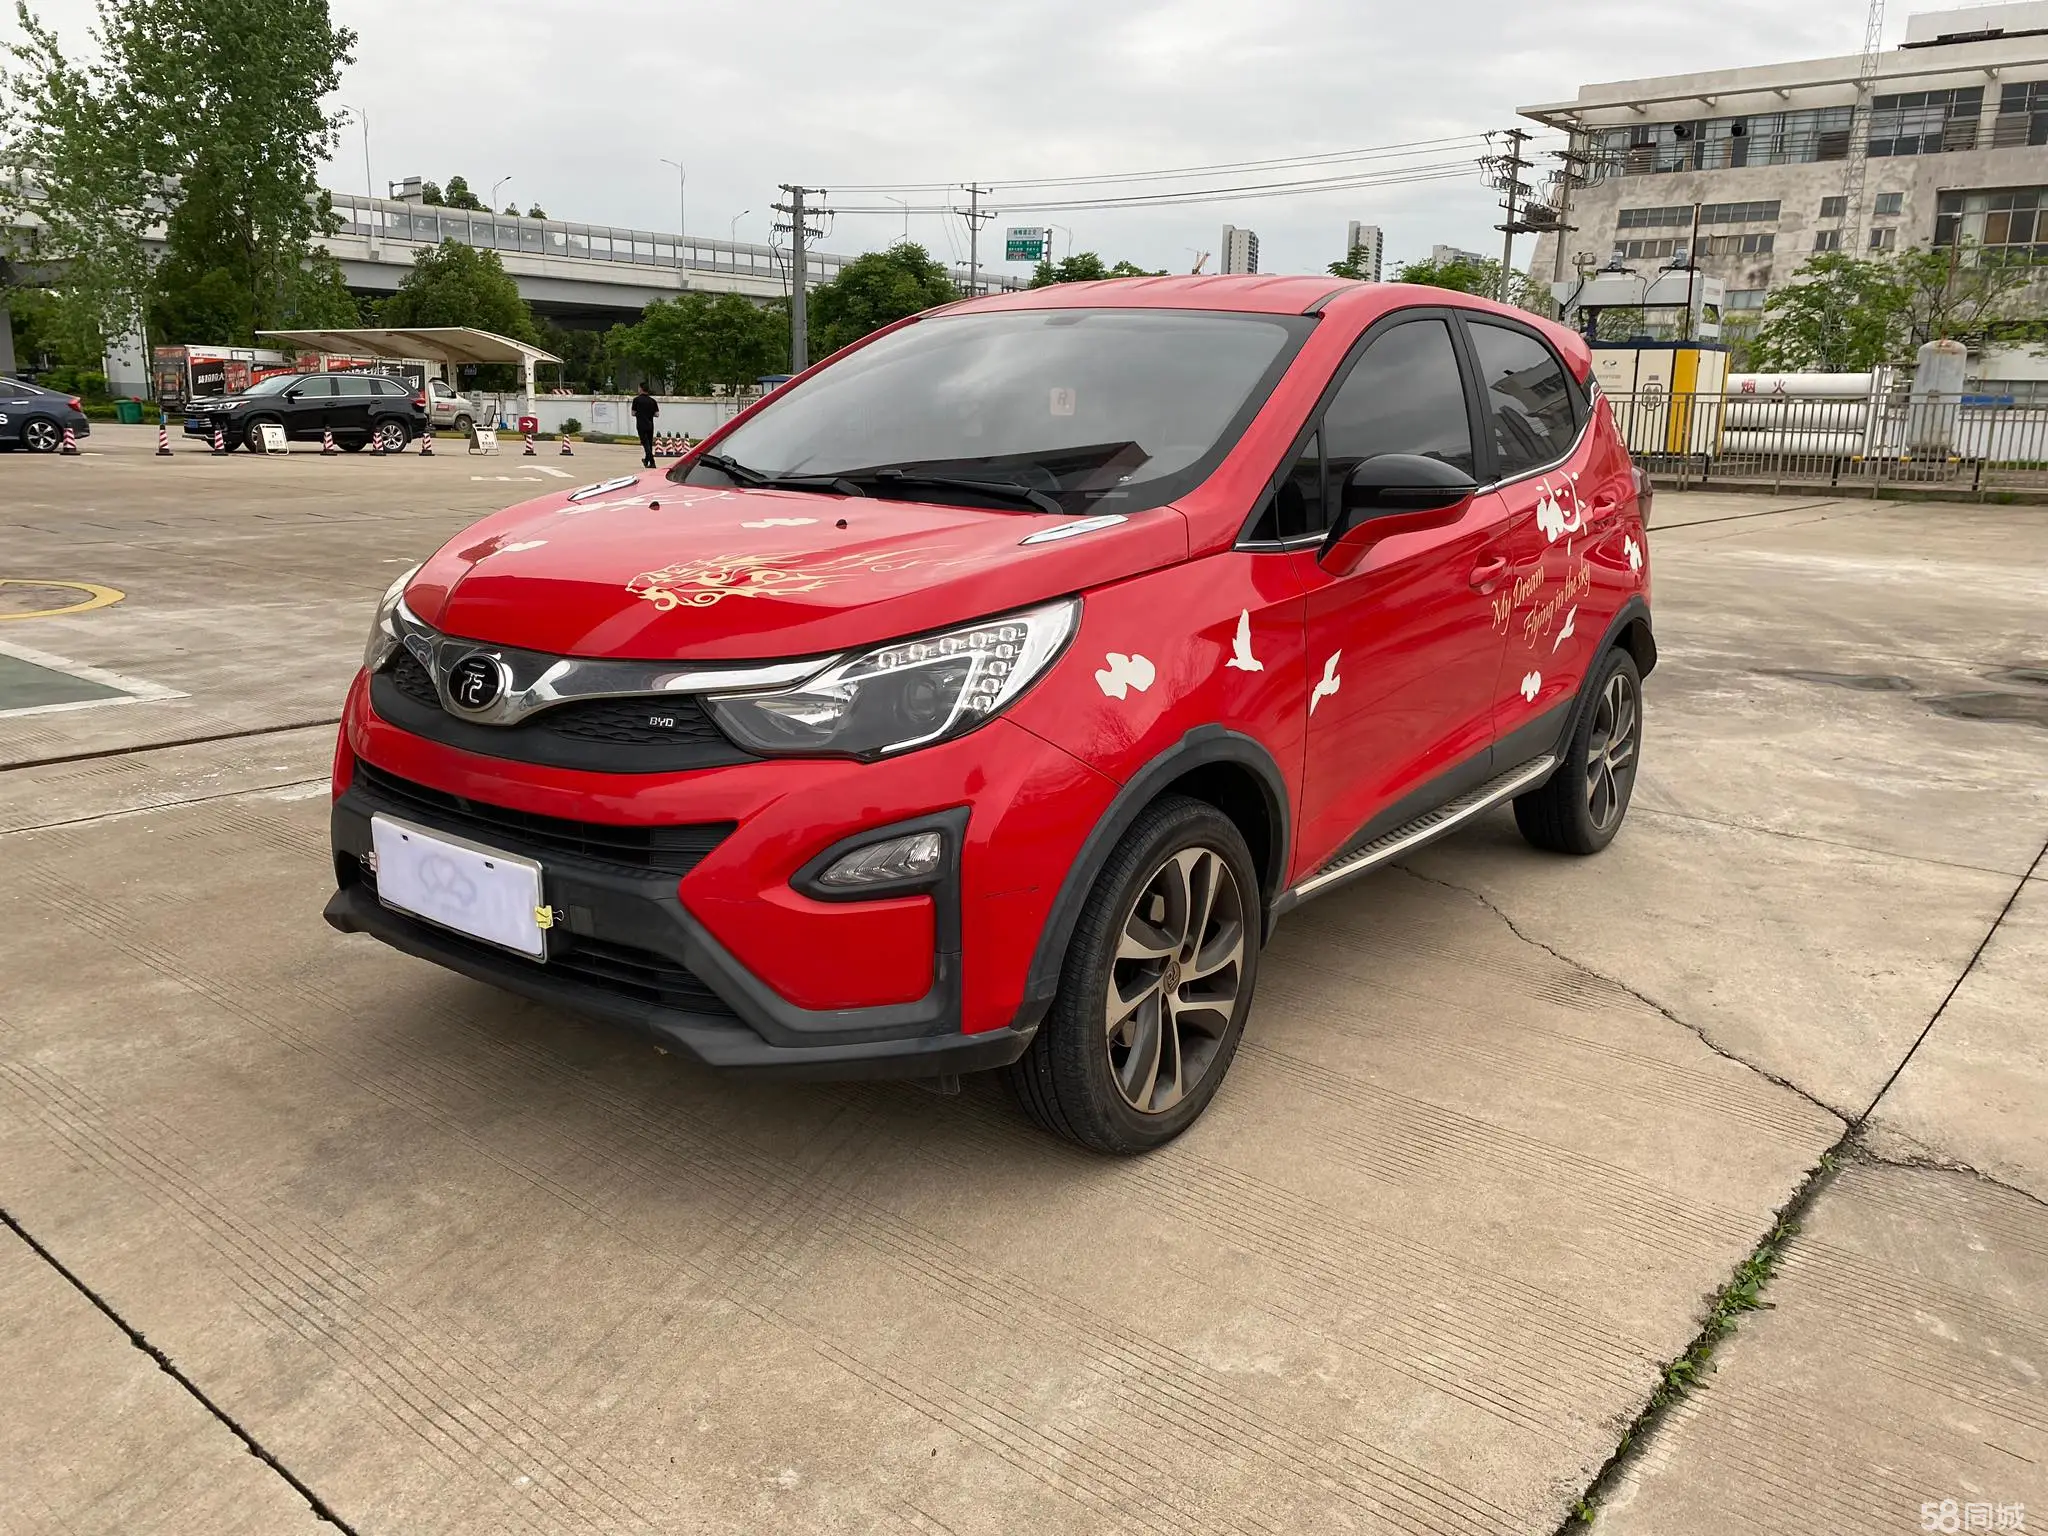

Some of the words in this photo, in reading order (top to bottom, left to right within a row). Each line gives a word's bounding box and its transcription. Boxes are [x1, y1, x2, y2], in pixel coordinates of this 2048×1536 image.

[1491, 590, 1512, 636] My
[1513, 565, 1544, 609] Dream
[1523, 600, 1554, 649] Flying
[1555, 588, 1564, 612] in
[1565, 565, 1577, 602] the
[1577, 557, 1590, 597] sky
[649, 716, 674, 727] BYD
